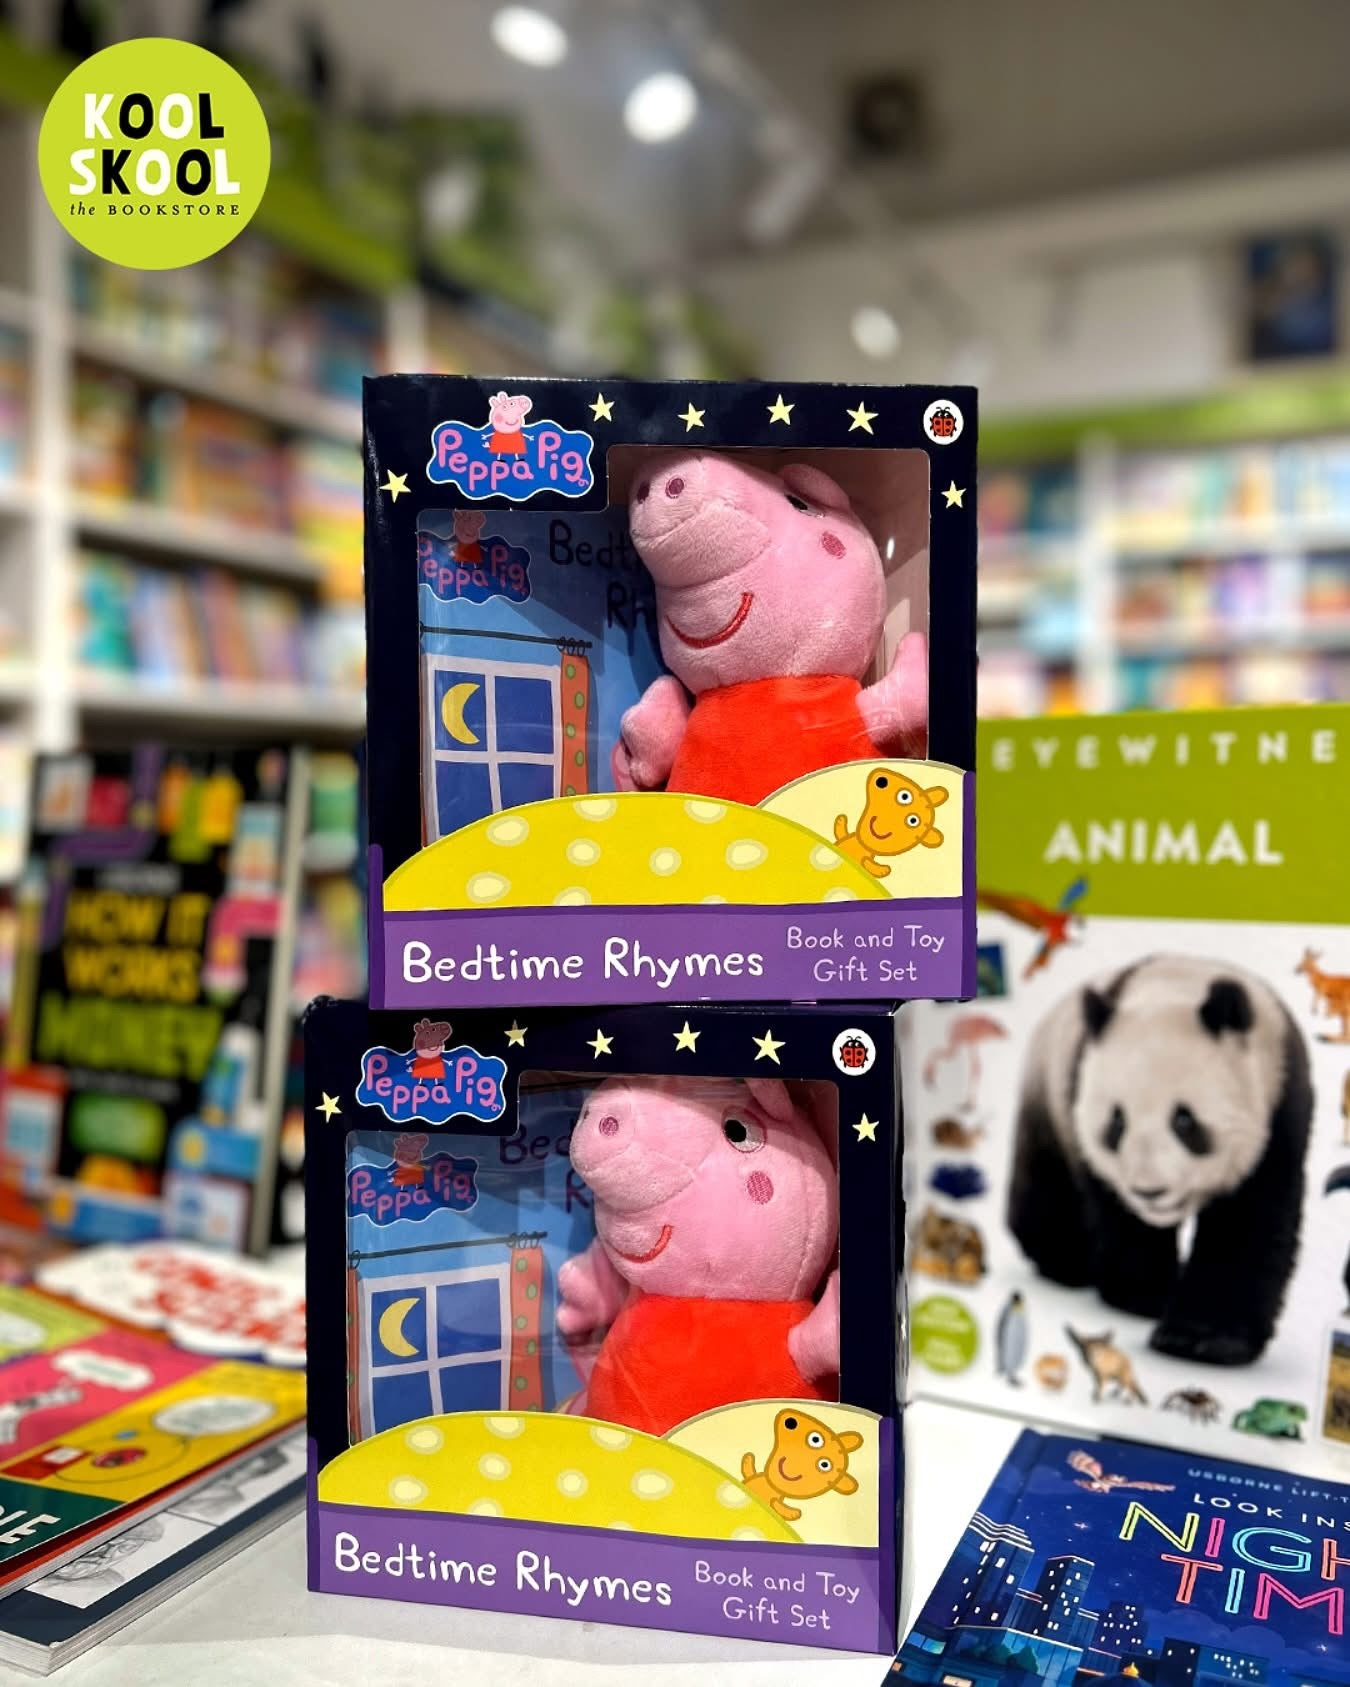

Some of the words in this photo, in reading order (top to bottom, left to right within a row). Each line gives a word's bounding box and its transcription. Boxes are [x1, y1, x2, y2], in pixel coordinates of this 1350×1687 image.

[438, 429, 534, 492] Peppa
[538, 431, 589, 486] Pig
[490, 544, 528, 595] Pig
[991, 729, 1337, 773] EYEWITNE
[1043, 819, 1285, 866] ANIMAL
[403, 940, 584, 984] Bedtime
[604, 937, 765, 989] Rhymes
[787, 926, 844, 949] Book
[854, 927, 894, 948] and
[903, 925, 946, 953] Toy
[813, 958, 869, 982] Gift
[879, 960, 918, 982] Set
[366, 1054, 452, 1114] Peppa
[456, 1057, 501, 1111] Pig
[351, 1170, 431, 1220] Peppa
[433, 1160, 474, 1203] Pig
[1187, 1467, 1284, 1492] USBORNE
[1193, 1493, 1284, 1520] LOOK
[1118, 1501, 1350, 1581] NIGH
[334, 1531, 497, 1587] Bedtime
[516, 1550, 672, 1607] Rhymes
[694, 1560, 755, 1589] Book
[763, 1573, 806, 1594] and
[815, 1571, 861, 1605] Toy
[722, 1597, 780, 1626] Gift
[790, 1604, 831, 1631] Set
[1160, 1553, 1345, 1636] TIM
